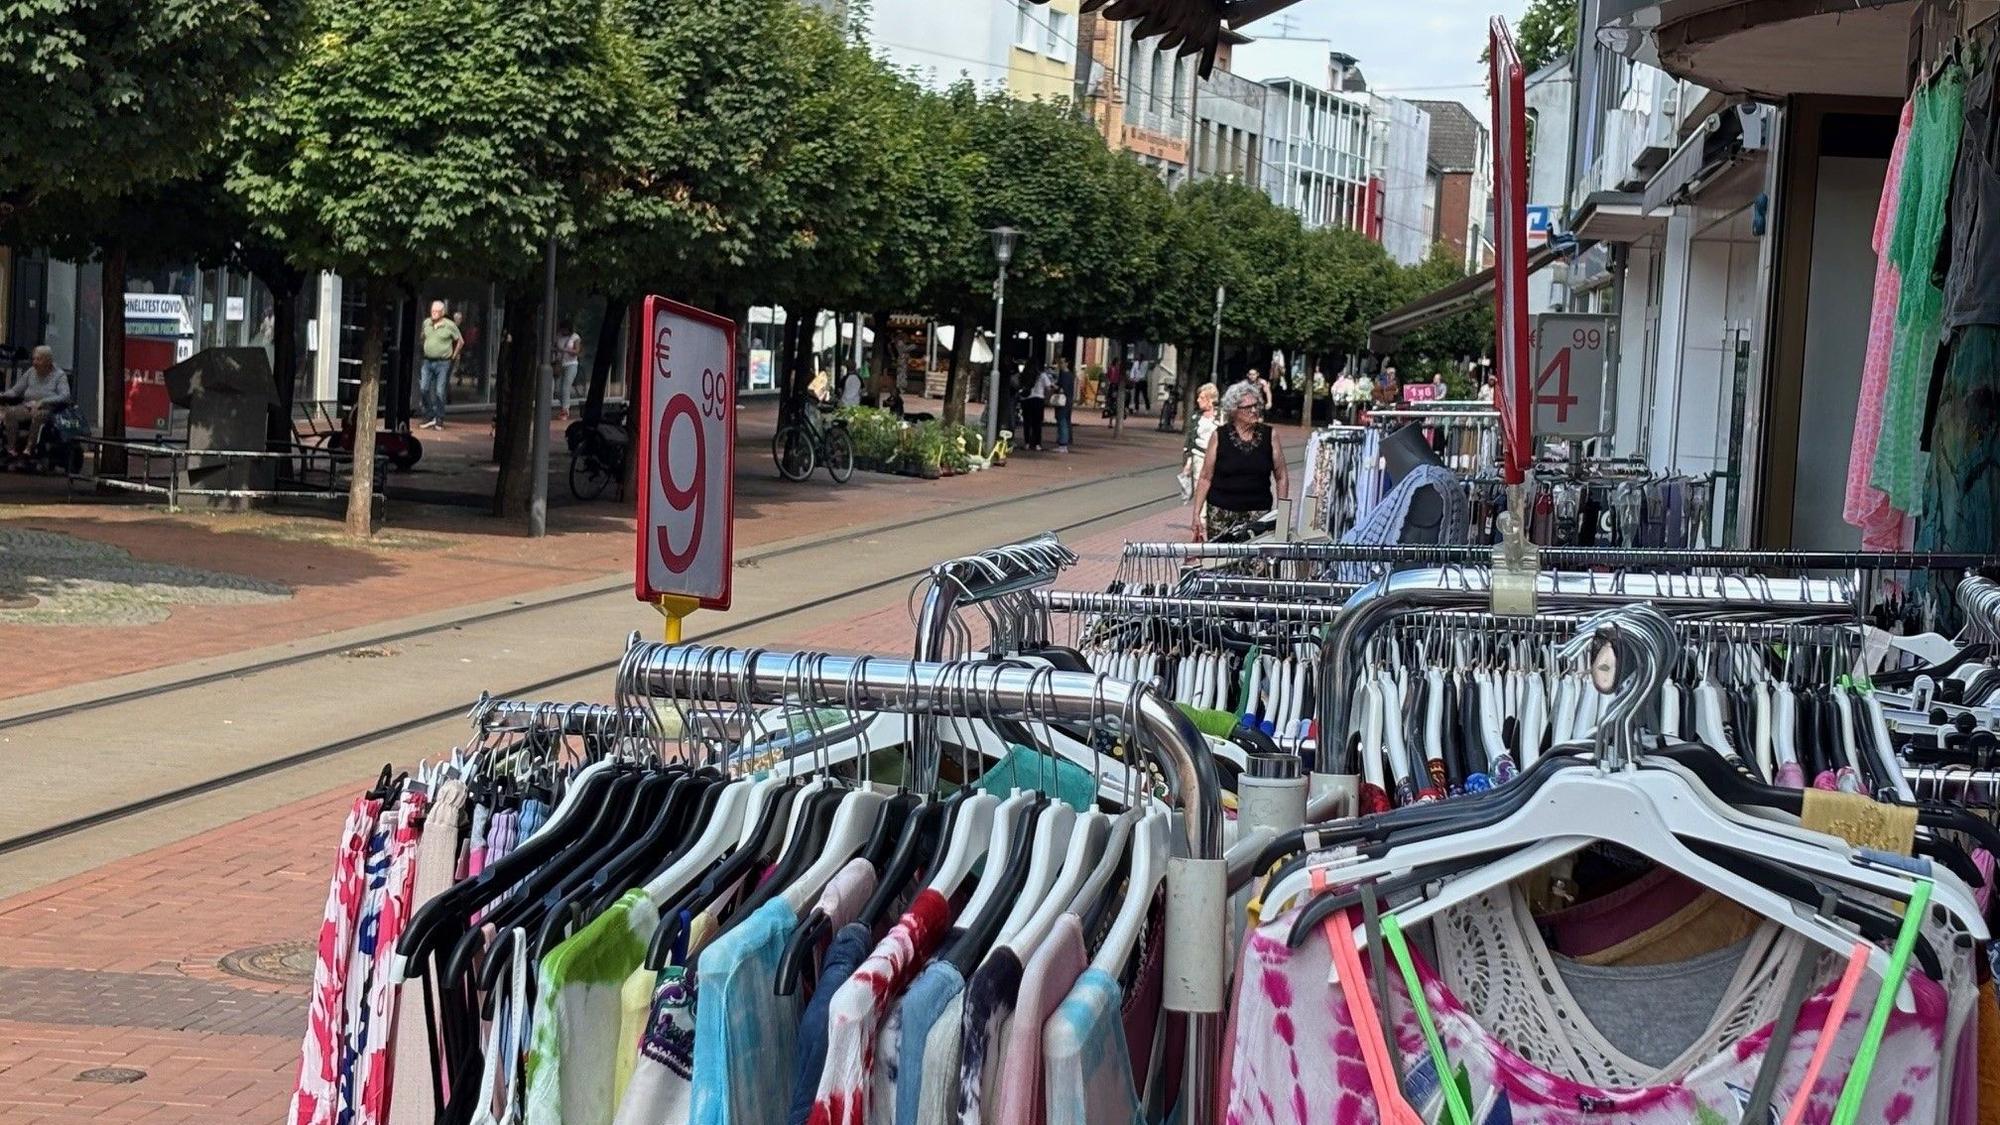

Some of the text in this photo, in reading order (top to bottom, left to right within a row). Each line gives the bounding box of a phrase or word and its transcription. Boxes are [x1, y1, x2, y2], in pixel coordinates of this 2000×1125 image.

[160, 300, 181, 314] COVID
[656, 327, 672, 378] €
[1572, 328, 1601, 350] 99
[1531, 346, 1579, 423] 4
[656, 368, 727, 574] 9 99
